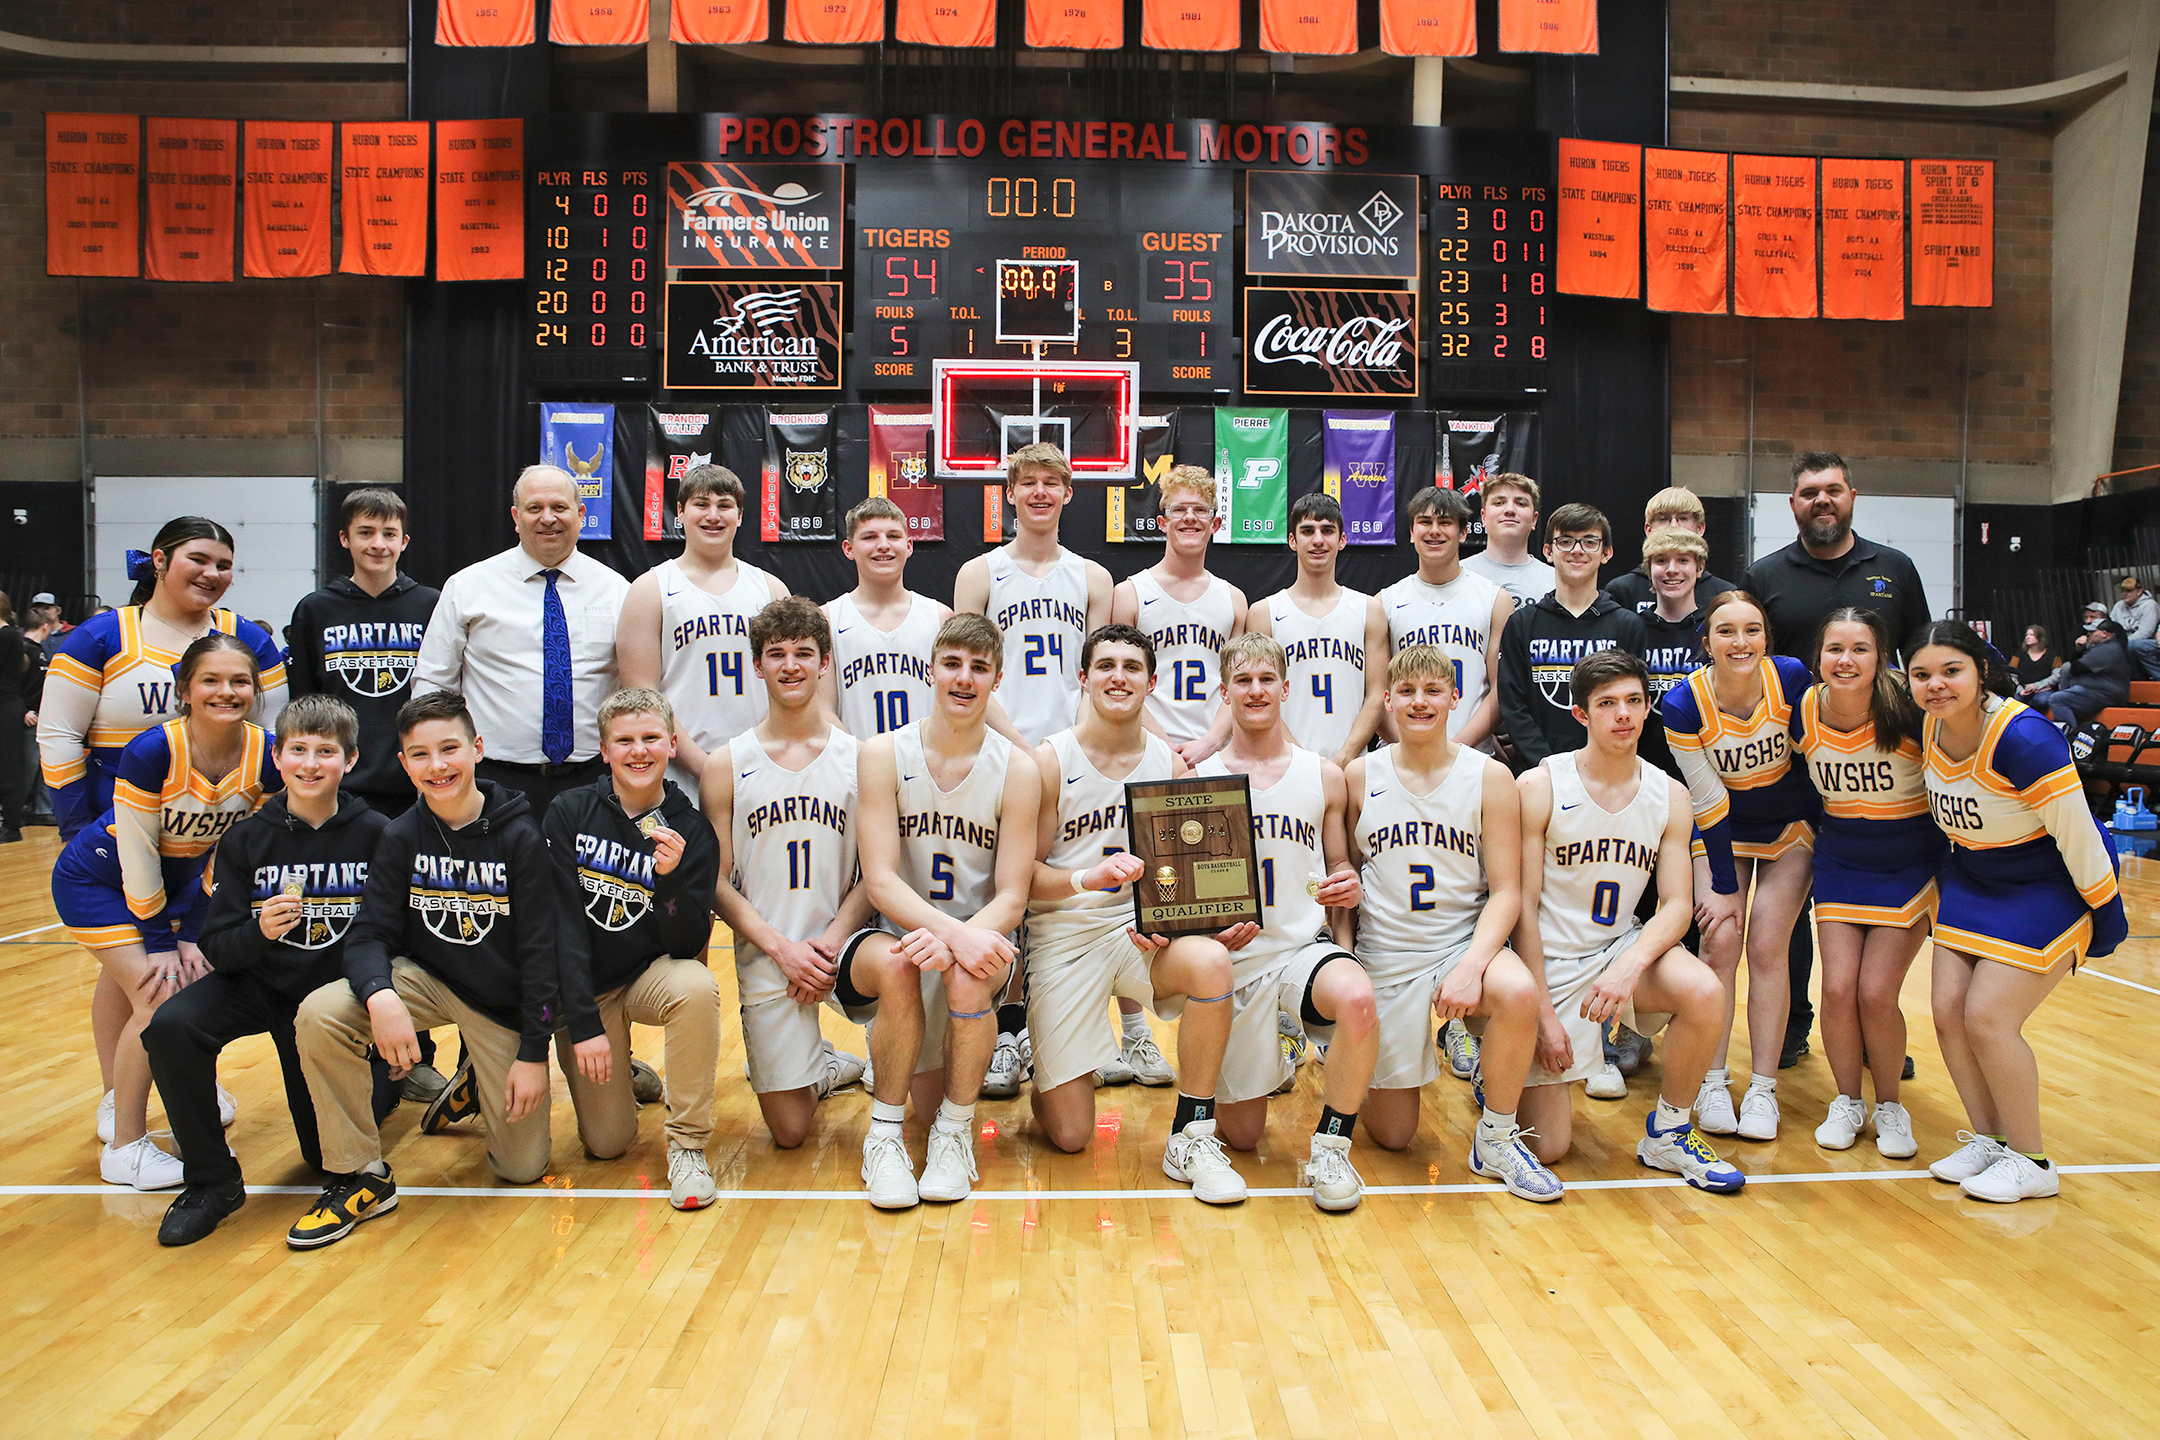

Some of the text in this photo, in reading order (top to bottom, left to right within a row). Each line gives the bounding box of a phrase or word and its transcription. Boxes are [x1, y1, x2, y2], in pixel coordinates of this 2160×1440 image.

[475, 8, 498, 17] 1952
[707, 5, 732, 14] 1963
[823, 5, 846, 14] 1973
[934, 7, 958, 17] 1974
[1063, 8, 1086, 18] 1978
[1180, 12, 1202, 21] 1981
[1299, 16, 1319, 24] 1981
[1416, 18, 1439, 27] 1983
[256, 138, 320, 150] HURON TIGERS
[352, 134, 418, 146] HURON TIGERS
[448, 137, 512, 151] HURON TIGERS
[718, 117, 1369, 166] PROSTROLLO GENERAL MOTORS
[344, 166, 425, 179] STATE CHAMPIONS
[1569, 156, 1631, 173] HURON TIGERS
[1920, 164, 1985, 177] HURON TIGERS
[247, 172, 329, 185] STATE CHAMPIONS
[439, 169, 522, 184] STATE CHAMPIONS
[537, 171, 648, 186] PLYR FLS PTS
[1656, 168, 1717, 183] HURON TIGERS
[1744, 174, 1805, 188] HURON TIGERS
[1832, 177, 1894, 190] HURON TIGERS
[1925, 175, 1980, 188] SPIRIT OF 6
[987, 177, 1075, 218] 00.0
[1439, 184, 1546, 201] PLYR FLS PTS
[1561, 187, 1637, 205] STATE CHAMPIONS
[555, 193, 647, 217] 4 0 0
[1648, 199, 1724, 215] STATE CHAMPIONS
[1737, 205, 1812, 220] STATE CHAMPIONS
[683, 209, 829, 232] Farmers Union
[1456, 207, 1544, 232] 3 0 0
[1825, 208, 1901, 221] STATE CHAMPIONS
[1260, 211, 1356, 241] DAKOTA
[547, 225, 647, 249] 10 0
[682, 235, 830, 249] INSURANCE
[863, 228, 951, 248] TIGERS
[1141, 232, 1223, 252] GUEST
[1267, 229, 1399, 260] PROVISIONS
[1582, 232, 1616, 242] WRESTLING
[1022, 246, 1066, 259] PERIOD
[1439, 238, 1545, 262] 22 0 11
[1589, 250, 1608, 259] 1994
[1924, 244, 1981, 257] SPIRIT AWARD
[546, 258, 646, 282] 12 0 0
[886, 256, 937, 297] 54
[1004, 268, 1057, 291] 00.0
[1163, 260, 1212, 301] 35
[1439, 269, 1545, 296] 23 8
[536, 290, 645, 314] 20 0 0
[875, 306, 914, 319] FOULS
[950, 307, 981, 320] T.O.L.
[1106, 308, 1137, 322] T.O.L.
[1172, 309, 1211, 322] FOULS
[1439, 301, 1507, 326] 25 3
[535, 322, 645, 347] 24 0 0
[687, 328, 818, 356] American
[890, 325, 908, 356] 5
[967, 328, 974, 355] 1
[1115, 328, 1132, 358] 3
[1253, 313, 1412, 367] Coca-Cola
[1199, 330, 1206, 358] 1
[1441, 333, 1545, 359] 32 2 8
[714, 361, 819, 374] BANK & TRUST
[874, 363, 914, 376] SCORE
[1172, 366, 1212, 380] SCORE
[771, 375, 817, 383] Member FDIC
[549, 412, 605, 424] ABERDEEN
[658, 412, 710, 425] BRANDON
[769, 413, 829, 426] BROOKINGS
[1233, 417, 1271, 428] PIERRE
[1328, 418, 1391, 430] WATERTOWN
[1448, 419, 1495, 432] YANKTON
[664, 424, 704, 436] VALLEY
[768, 464, 777, 531] BOBCATS
[1221, 448, 1229, 532] GOVERNORS
[997, 598, 1086, 633] SPARTANS
[323, 622, 424, 651] SPARTANS
[1023, 633, 1064, 677] 24
[705, 651, 744, 697] 14
[843, 652, 932, 690] SPARTANS
[1172, 659, 1207, 702] 12
[1310, 672, 1334, 715] 4
[873, 690, 909, 735] 10
[1713, 731, 1786, 774] WSHS
[1815, 760, 1895, 793] WSHS
[1165, 794, 1214, 808] STATE
[747, 795, 847, 839] SPARTANS
[898, 810, 996, 851] SPARTANS
[1369, 820, 1475, 860] SPARTANS
[786, 838, 811, 891] 11
[1210, 861, 1242, 869] BASKETBALL
[929, 852, 955, 901] 5
[1260, 857, 1275, 908] 1
[1408, 863, 1437, 913] 2
[411, 897, 508, 914] BASKETBALL
[1152, 901, 1245, 921] QUALIFIER
[1589, 879, 1621, 928] 0
